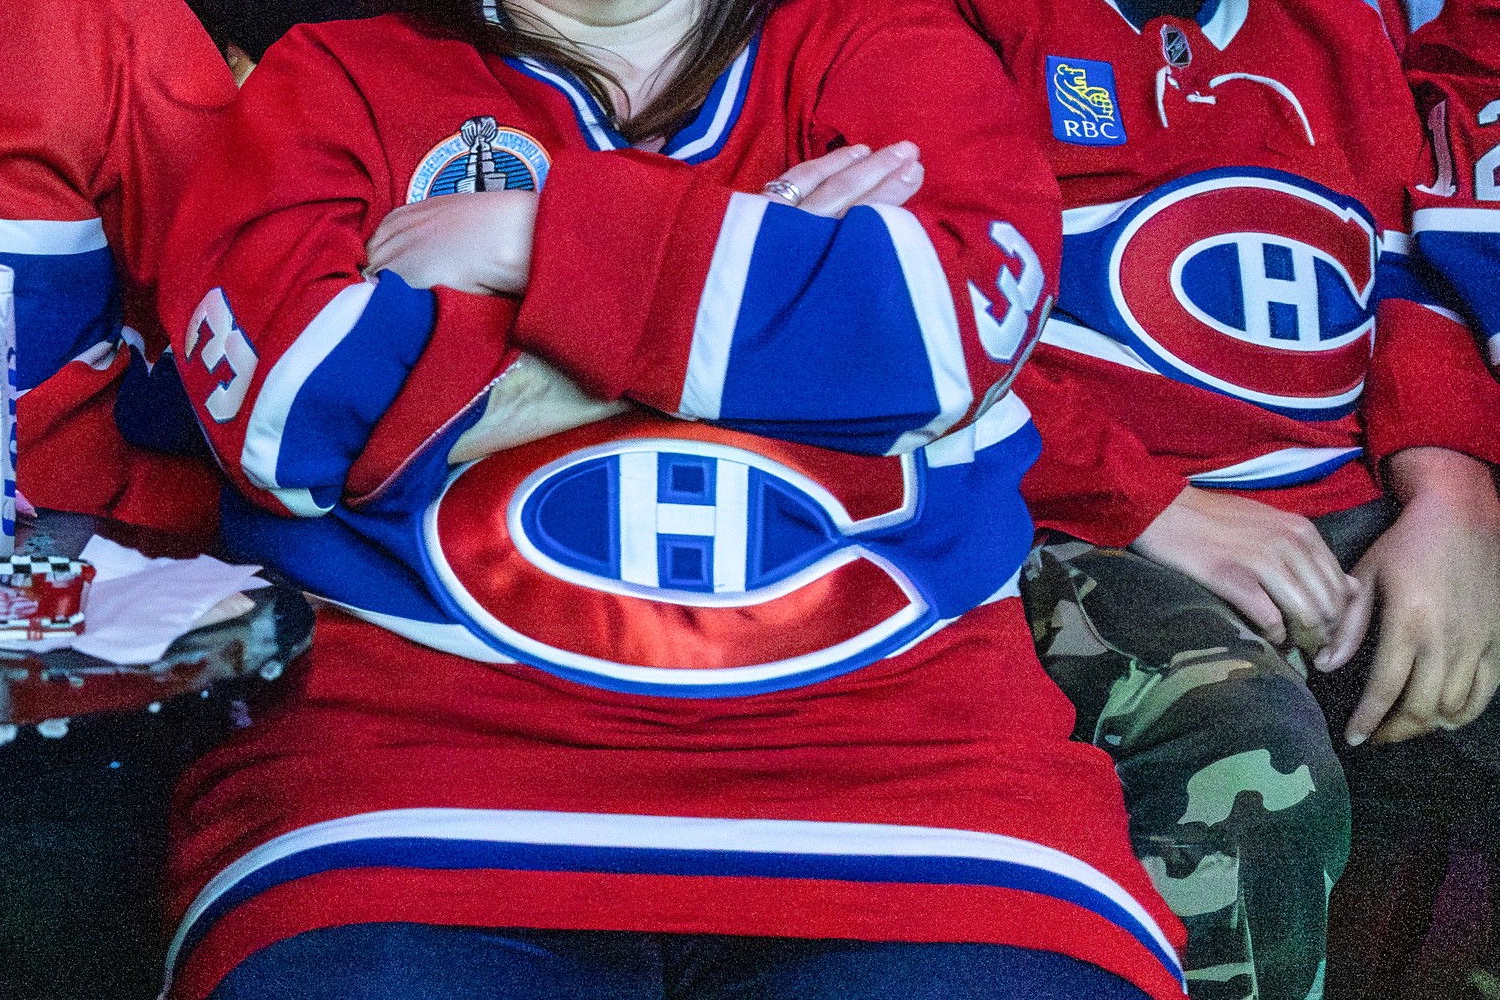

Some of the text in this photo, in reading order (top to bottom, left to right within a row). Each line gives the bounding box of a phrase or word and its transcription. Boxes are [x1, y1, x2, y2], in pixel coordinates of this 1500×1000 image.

[1063, 119, 1119, 139] RBC
[184, 286, 260, 424] 3
[967, 220, 1046, 364] 3
